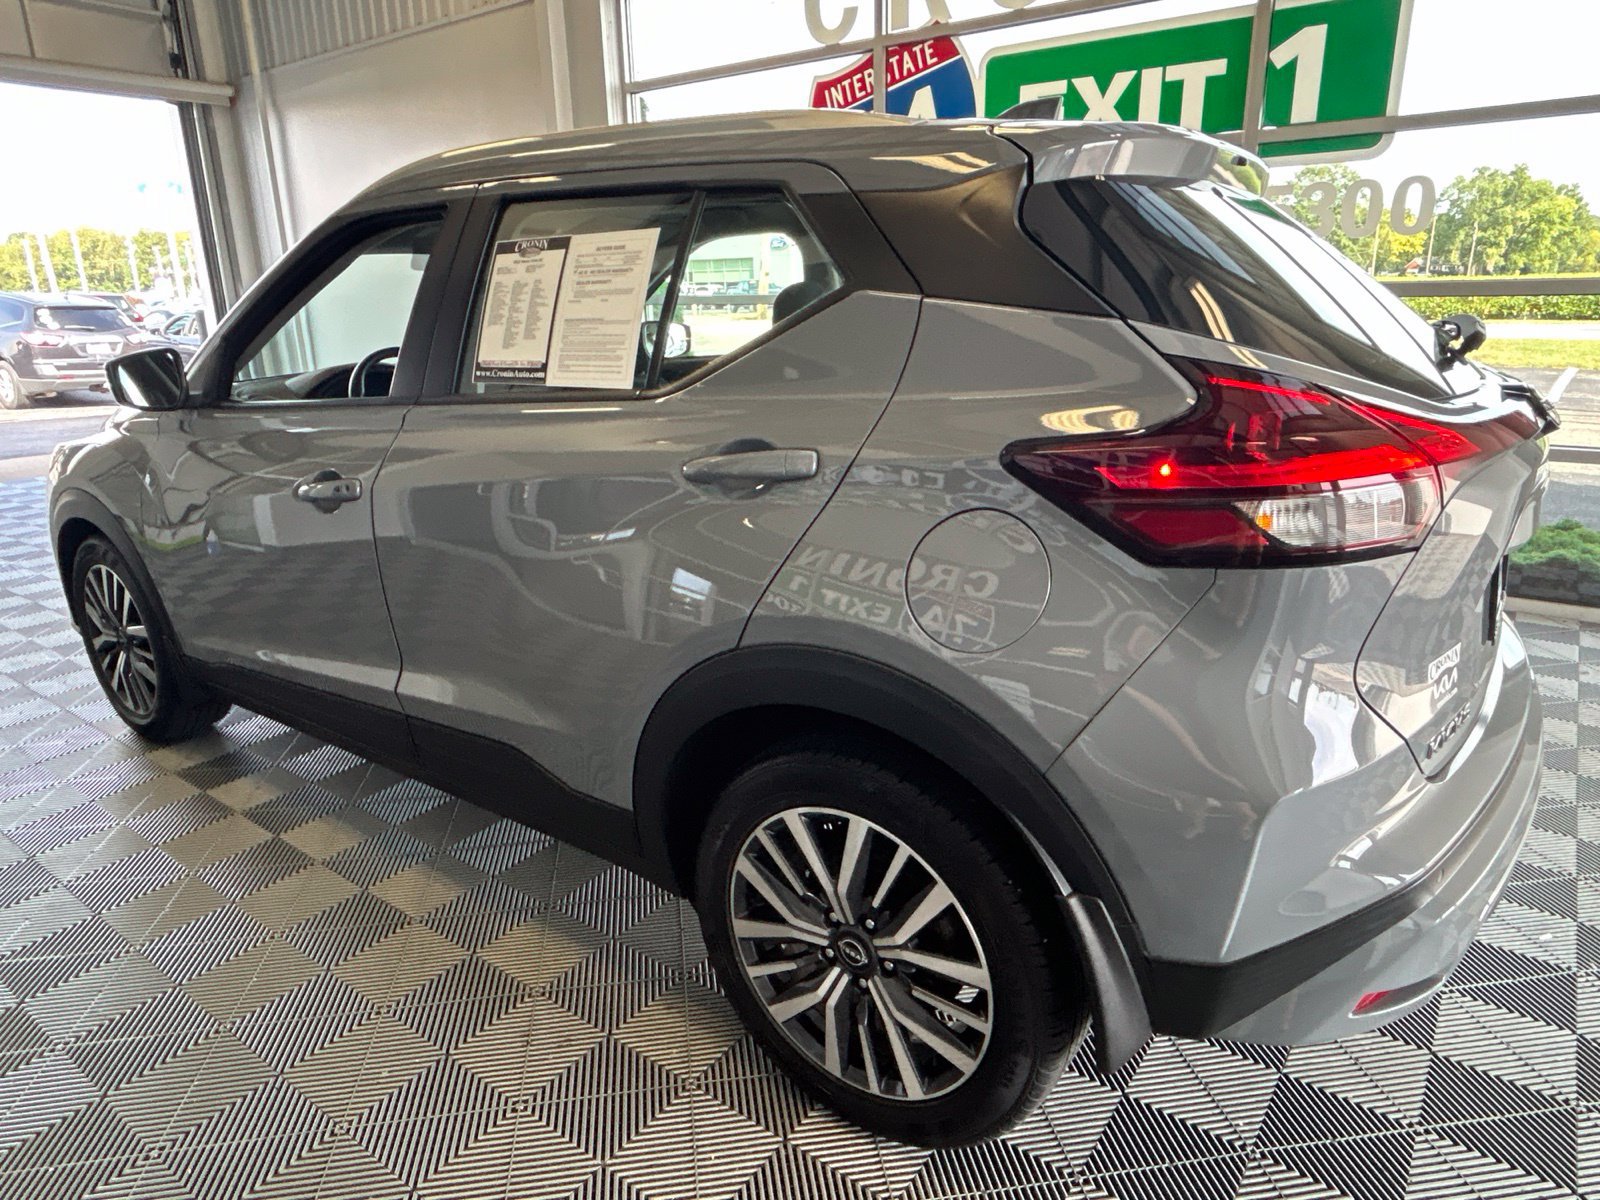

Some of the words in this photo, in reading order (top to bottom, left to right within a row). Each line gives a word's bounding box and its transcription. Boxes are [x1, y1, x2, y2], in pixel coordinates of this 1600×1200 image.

[824, 40, 938, 109] INTERTATE
[1269, 24, 1328, 125] 1
[514, 239, 549, 252] CRONIN
[475, 369, 545, 378] www.CroninAuto.com
[1429, 647, 1458, 681] CRONIN
